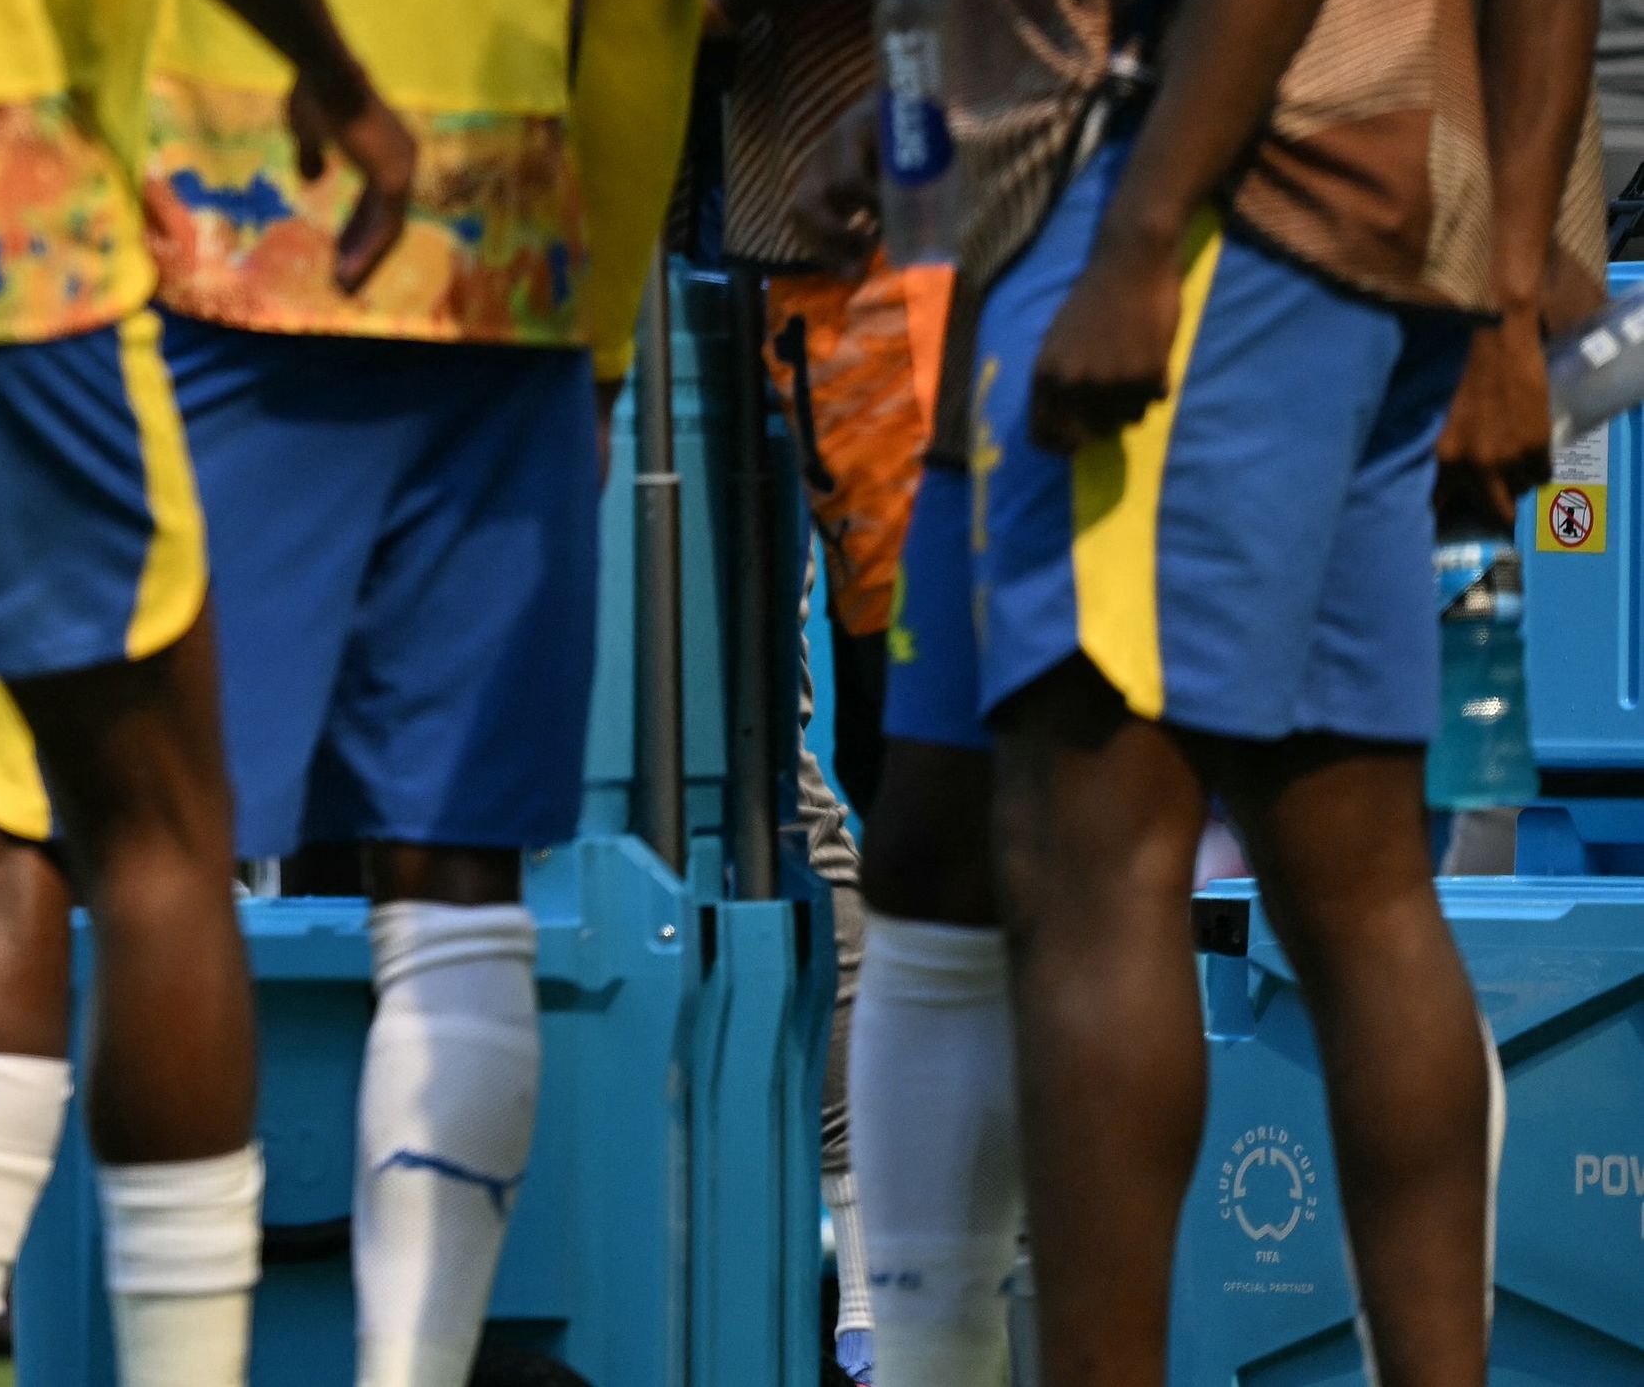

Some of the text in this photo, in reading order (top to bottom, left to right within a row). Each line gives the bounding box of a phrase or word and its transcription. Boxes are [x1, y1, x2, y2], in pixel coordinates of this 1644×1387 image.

[1218, 1161, 1234, 1220] CLUB
[1231, 1125, 1289, 1157] WORLD
[1293, 1143, 1317, 1184] CUP
[1255, 1250, 1281, 1264] FIFA
